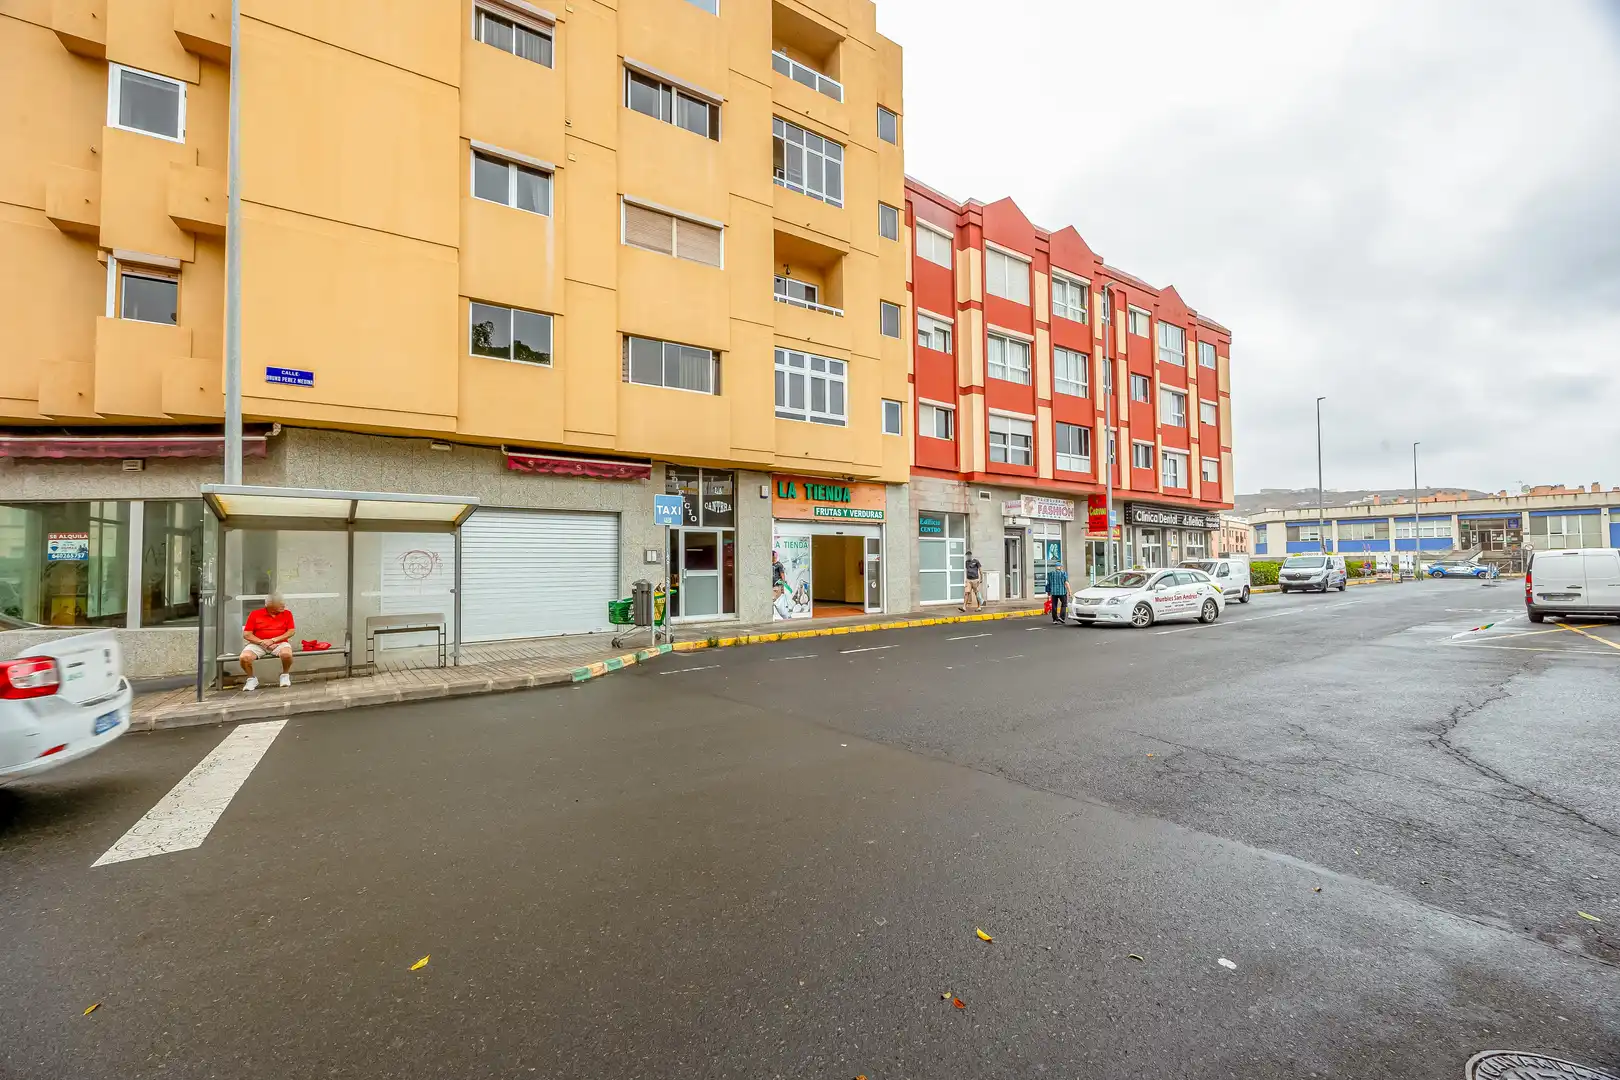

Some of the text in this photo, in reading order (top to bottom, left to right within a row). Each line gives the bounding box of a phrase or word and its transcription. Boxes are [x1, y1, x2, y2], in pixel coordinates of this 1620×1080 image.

[778, 480, 851, 503] LA TIENDA
[656, 505, 681, 516] TAXI
[816, 507, 883, 519] FRUTAS Y VERDURAS
[1037, 504, 1074, 517] FASHION
[1159, 513, 1178, 525] Dental
[784, 541, 809, 549] TIENDA
